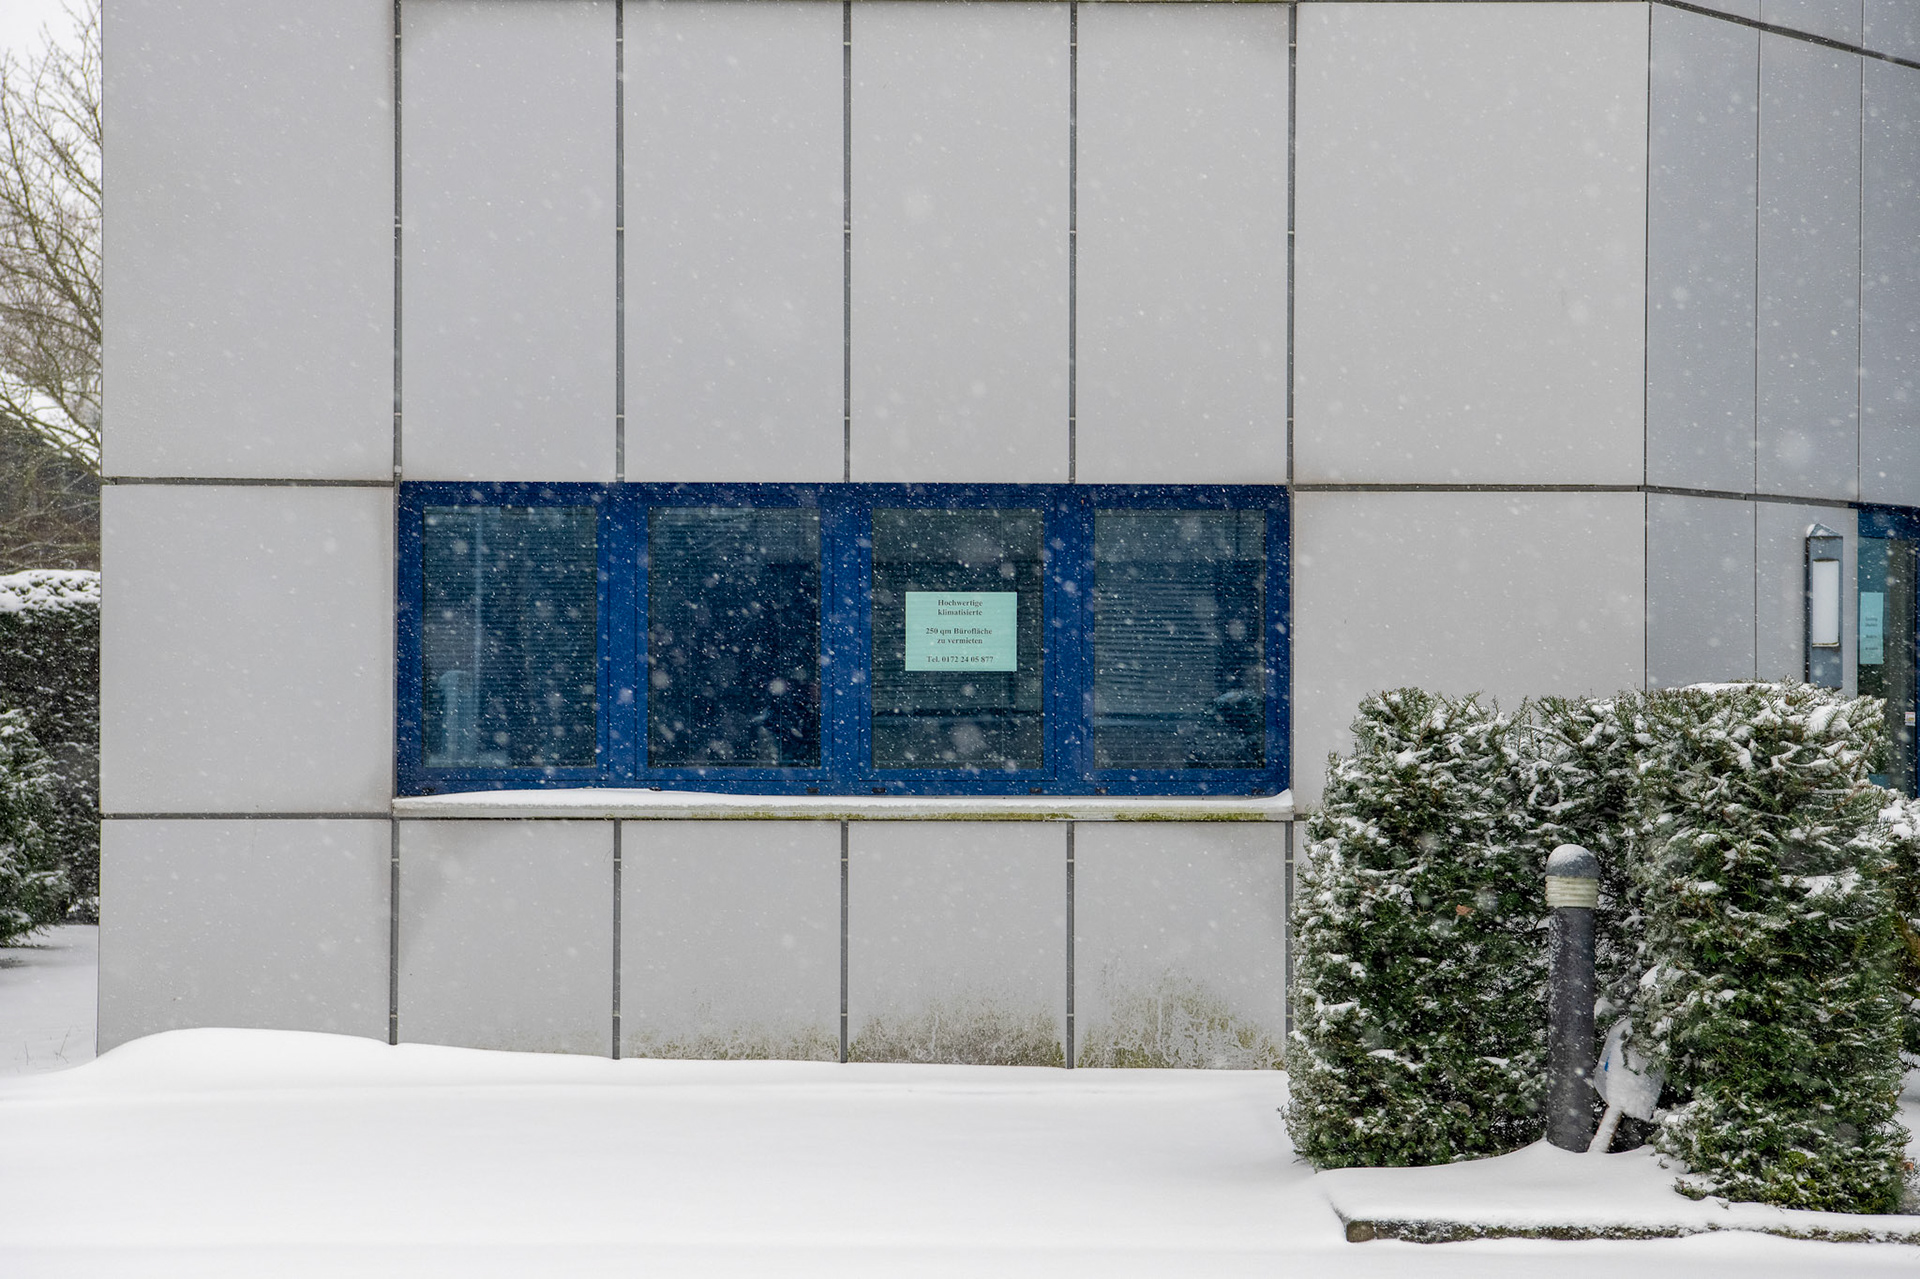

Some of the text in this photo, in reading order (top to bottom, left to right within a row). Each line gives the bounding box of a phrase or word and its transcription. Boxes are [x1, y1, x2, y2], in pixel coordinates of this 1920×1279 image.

[938, 599, 983, 607] Hochwertige
[926, 627, 938, 635] 250
[954, 627, 993, 635] Bürofläche
[927, 655, 994, 663] Tel. 0172 24 05 877
